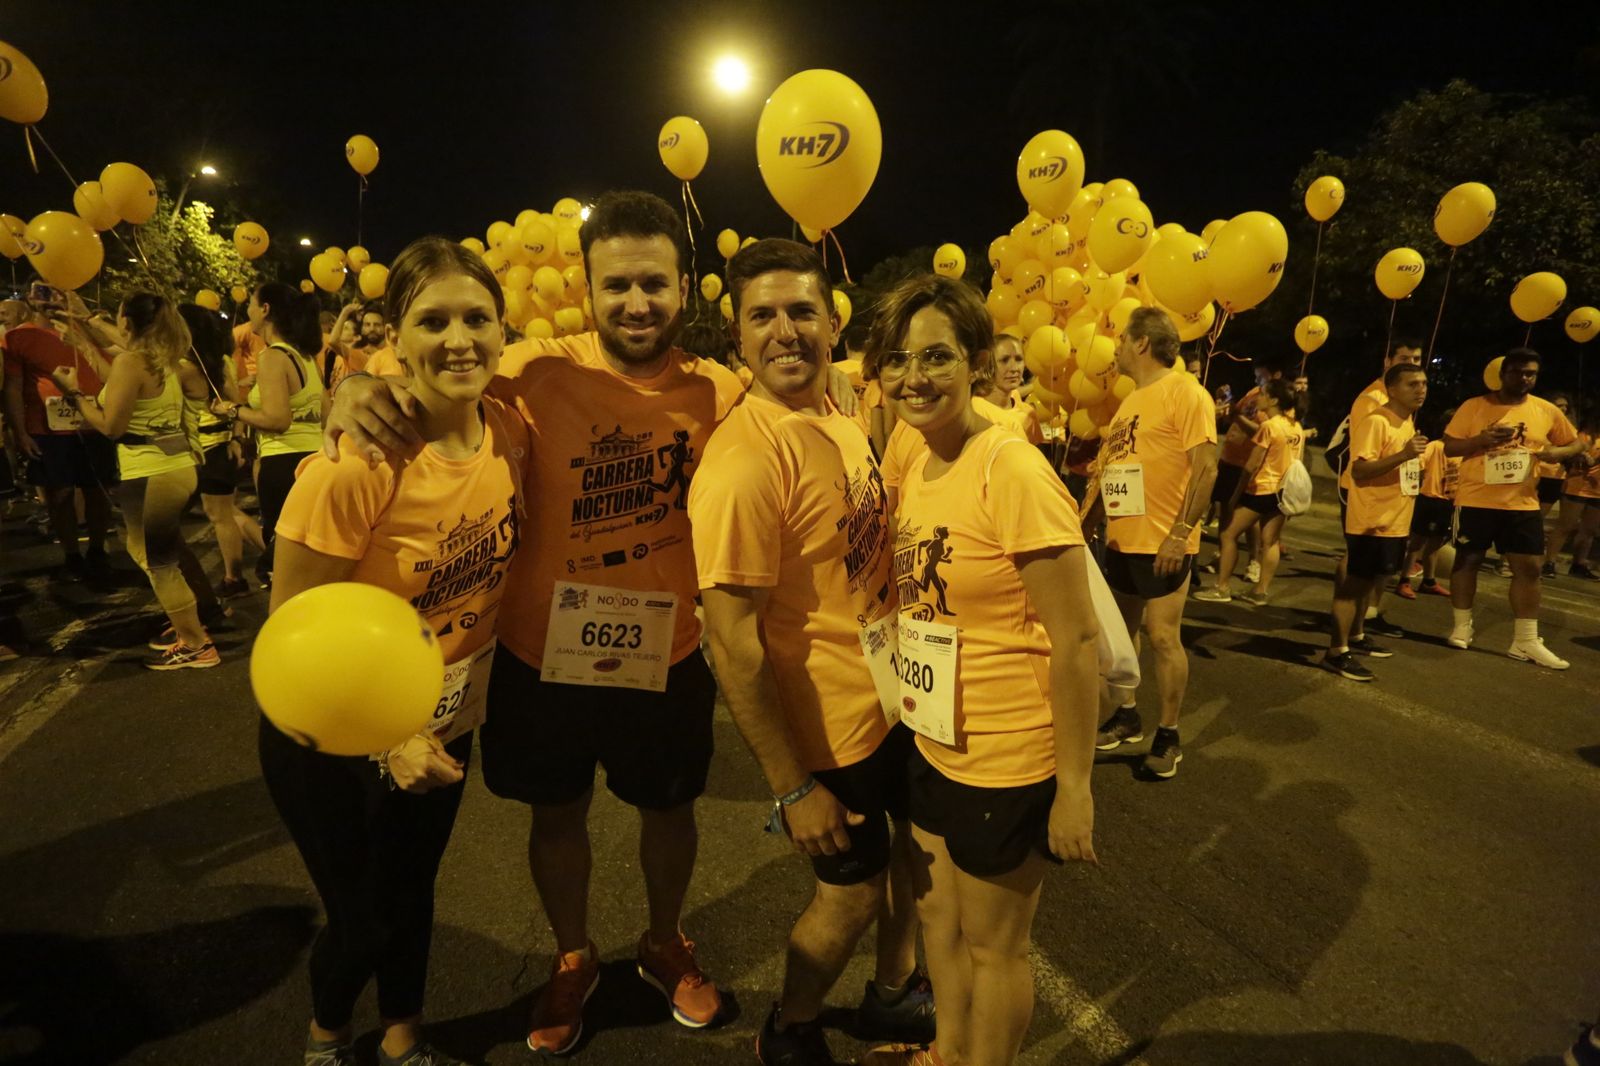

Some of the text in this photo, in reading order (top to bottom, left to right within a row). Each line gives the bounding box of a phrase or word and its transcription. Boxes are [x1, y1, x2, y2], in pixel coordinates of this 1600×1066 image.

[570, 457, 585, 468] XXXI
[582, 454, 654, 492] CARRERA
[1494, 461, 1523, 471] 11363
[571, 484, 654, 522] NOCTURNA
[847, 485, 875, 545] CARRERA
[427, 531, 497, 589] CARRERA
[844, 512, 881, 579] NOCTURNA
[413, 559, 433, 573] XXXI
[581, 621, 642, 649] 6623
[555, 647, 662, 662] JUAN CARLOS RIVAS TEJERO
